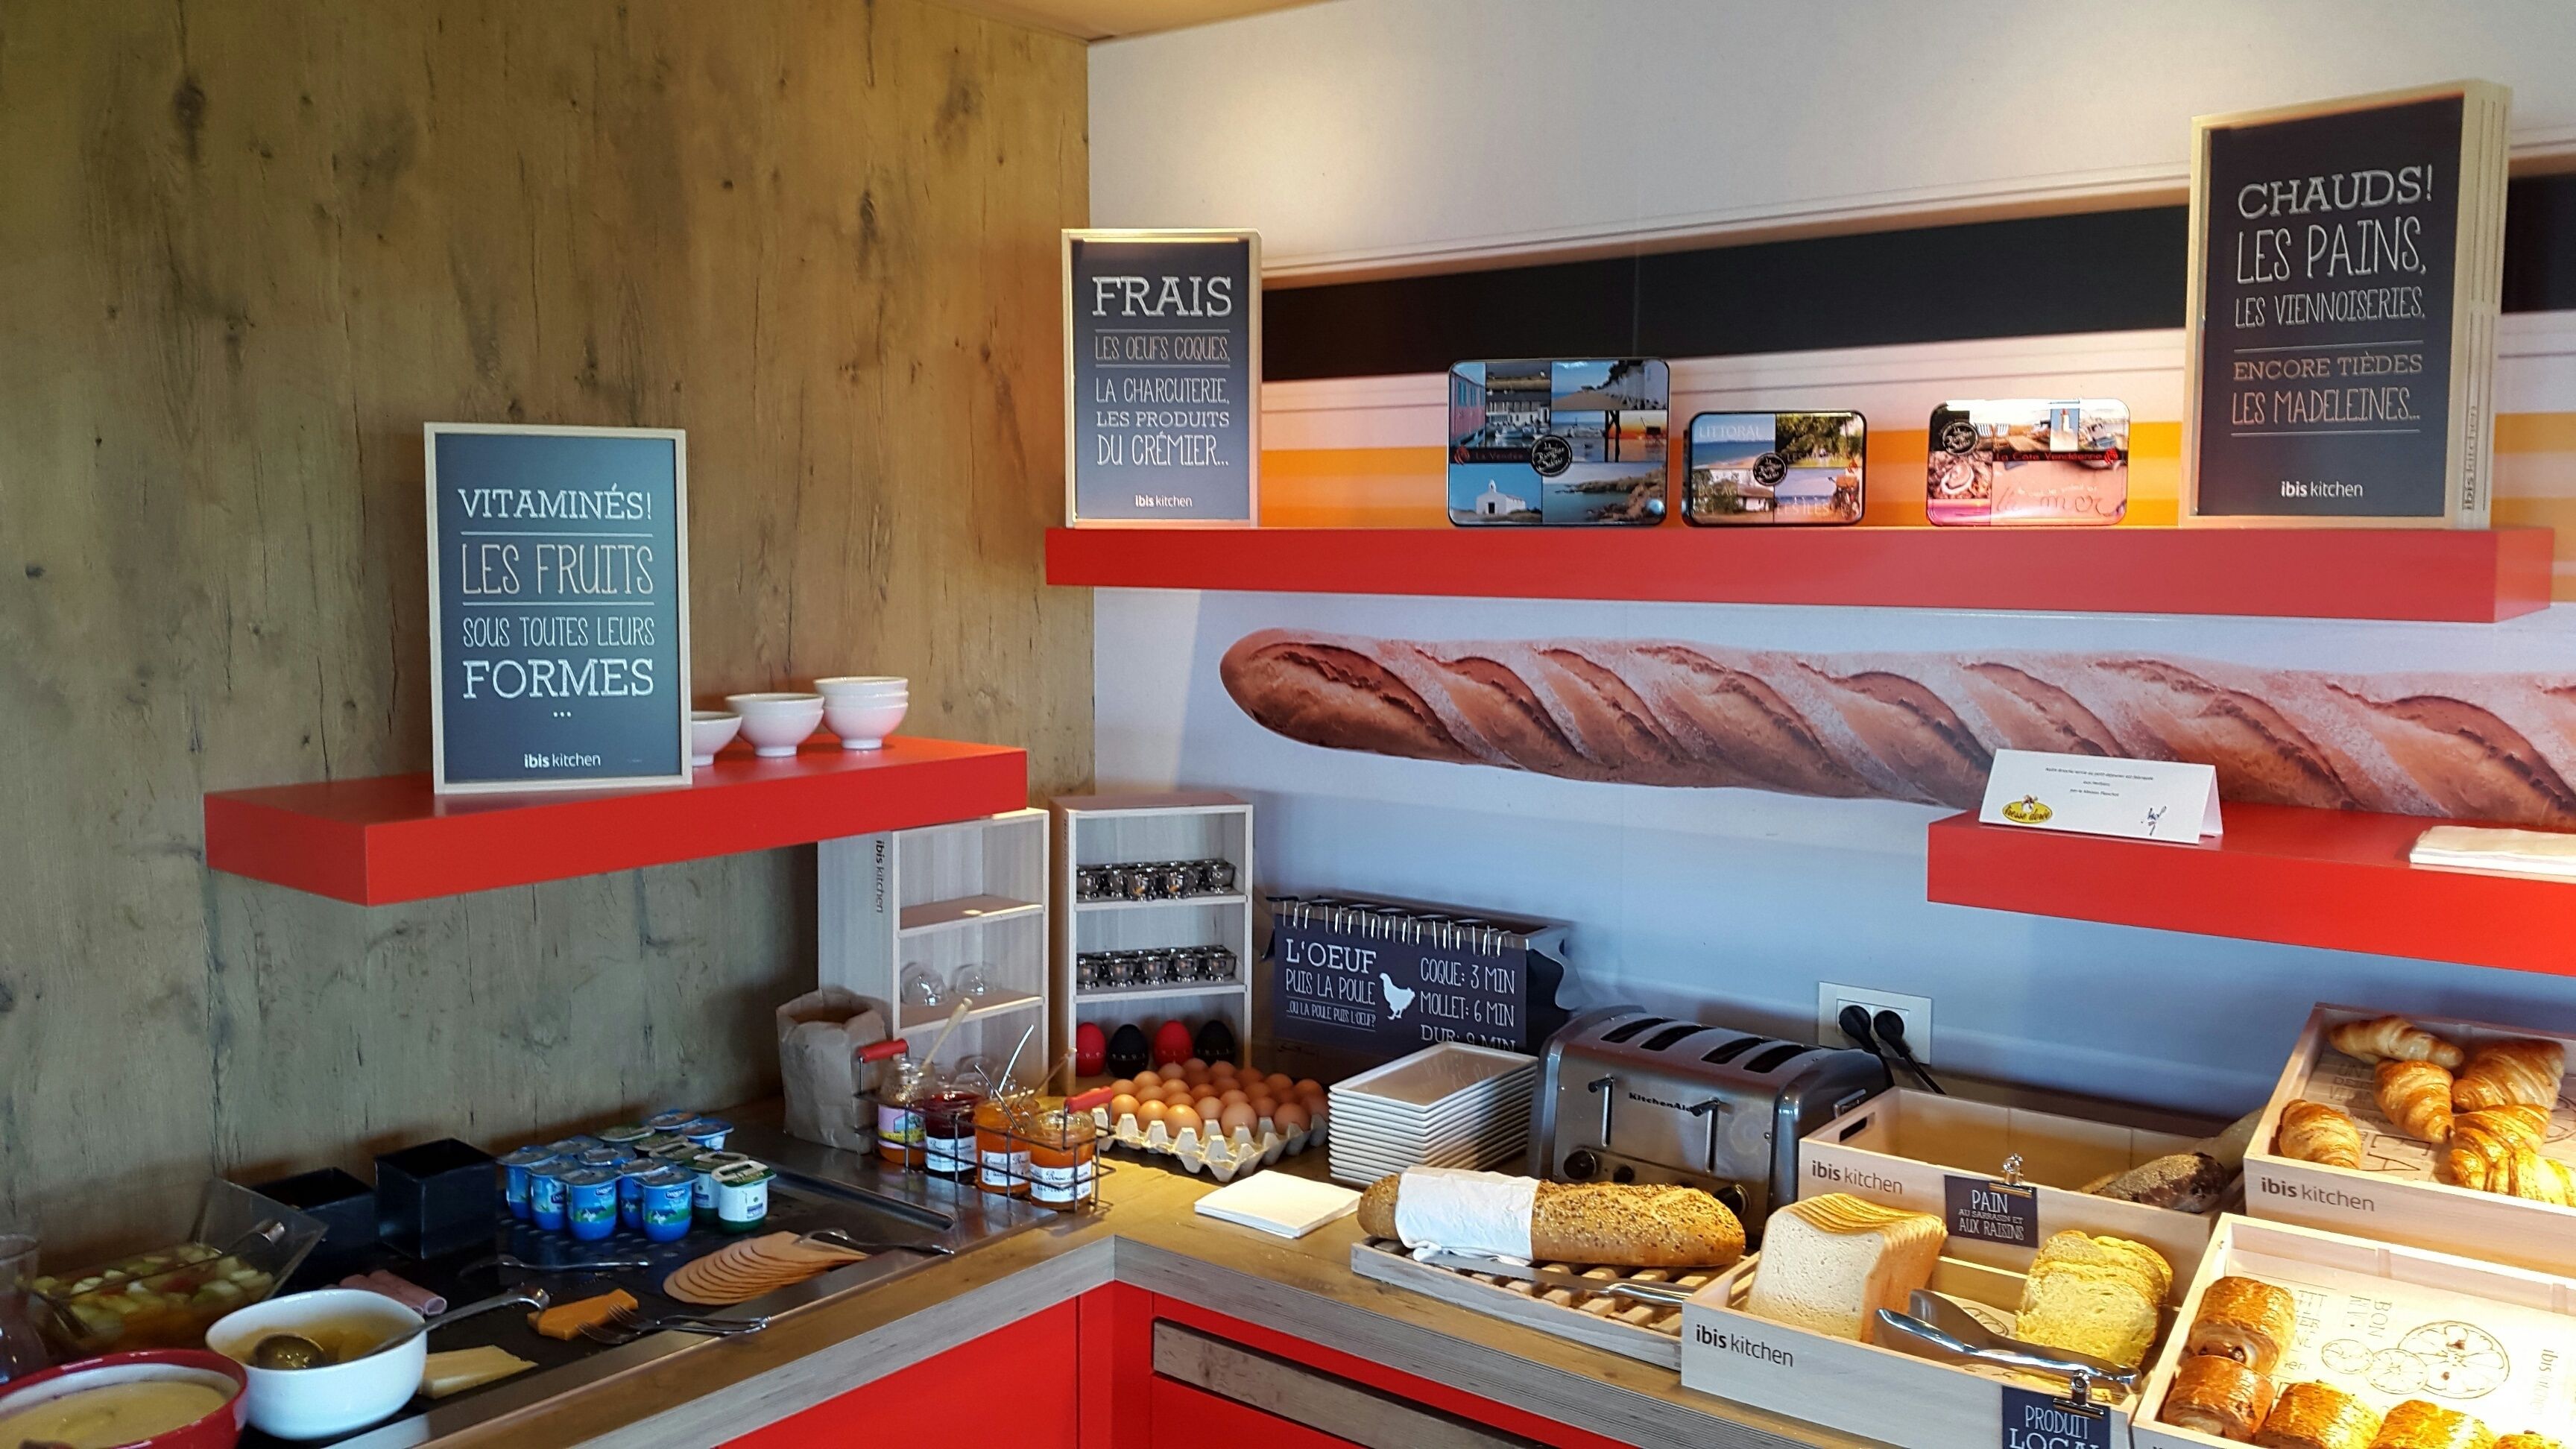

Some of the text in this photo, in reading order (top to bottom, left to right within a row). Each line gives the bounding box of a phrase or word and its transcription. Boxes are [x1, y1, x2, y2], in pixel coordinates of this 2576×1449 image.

[2238, 164, 2433, 220] CHAUDS!
[2237, 216, 2427, 284] LES PAINS,
[1092, 276, 1232, 318] FRAIS
[2235, 286, 2425, 328] LES VIENNOISERIES,
[1095, 336, 1231, 362] LES OEUFS COQUES,
[2233, 351, 2422, 381] ENCORE TIÈDES
[1096, 377, 1230, 405] LA CHARCUTERIE,
[1096, 411, 1229, 428] LES PRODUITS
[2232, 391, 2265, 426] LES
[1699, 426, 1762, 438] LITTORAL
[1096, 435, 1123, 466] DU
[458, 483, 652, 520] VITAMINÉS!
[1135, 493, 1193, 508] ibis kitchen
[2281, 481, 2363, 499] ibis kitchen
[461, 543, 654, 595] LES FRUITS
[463, 617, 655, 647] SOUS TOUTES LEURS
[462, 659, 654, 699] FORMES
[524, 752, 602, 768] ibis kitchen
[876, 840, 885, 914] ibis kitchen
[1286, 939, 1377, 973] L'OEUF
[1286, 969, 1376, 1006] PUIS LA POULE
[1421, 957, 1515, 994] COQUE: 3 MIN
[1300, 1002, 1310, 1016] LA
[1312, 1003, 1332, 1020] POULE
[1333, 1008, 1349, 1023] PUIS
[1420, 990, 1515, 1028] MOLLET: 6 MIN
[1811, 1160, 1902, 1194] ibis kitchen
[2261, 1176, 2375, 1212] ibis kitchen
[1958, 1208, 1970, 1216] AU
[1972, 1190, 2008, 1213] PAIN
[1959, 1217, 2024, 1240] AUX RAISINS
[1696, 1324, 1794, 1368] ibis kitchen
[2025, 1405, 2090, 1439] PRODUIT
